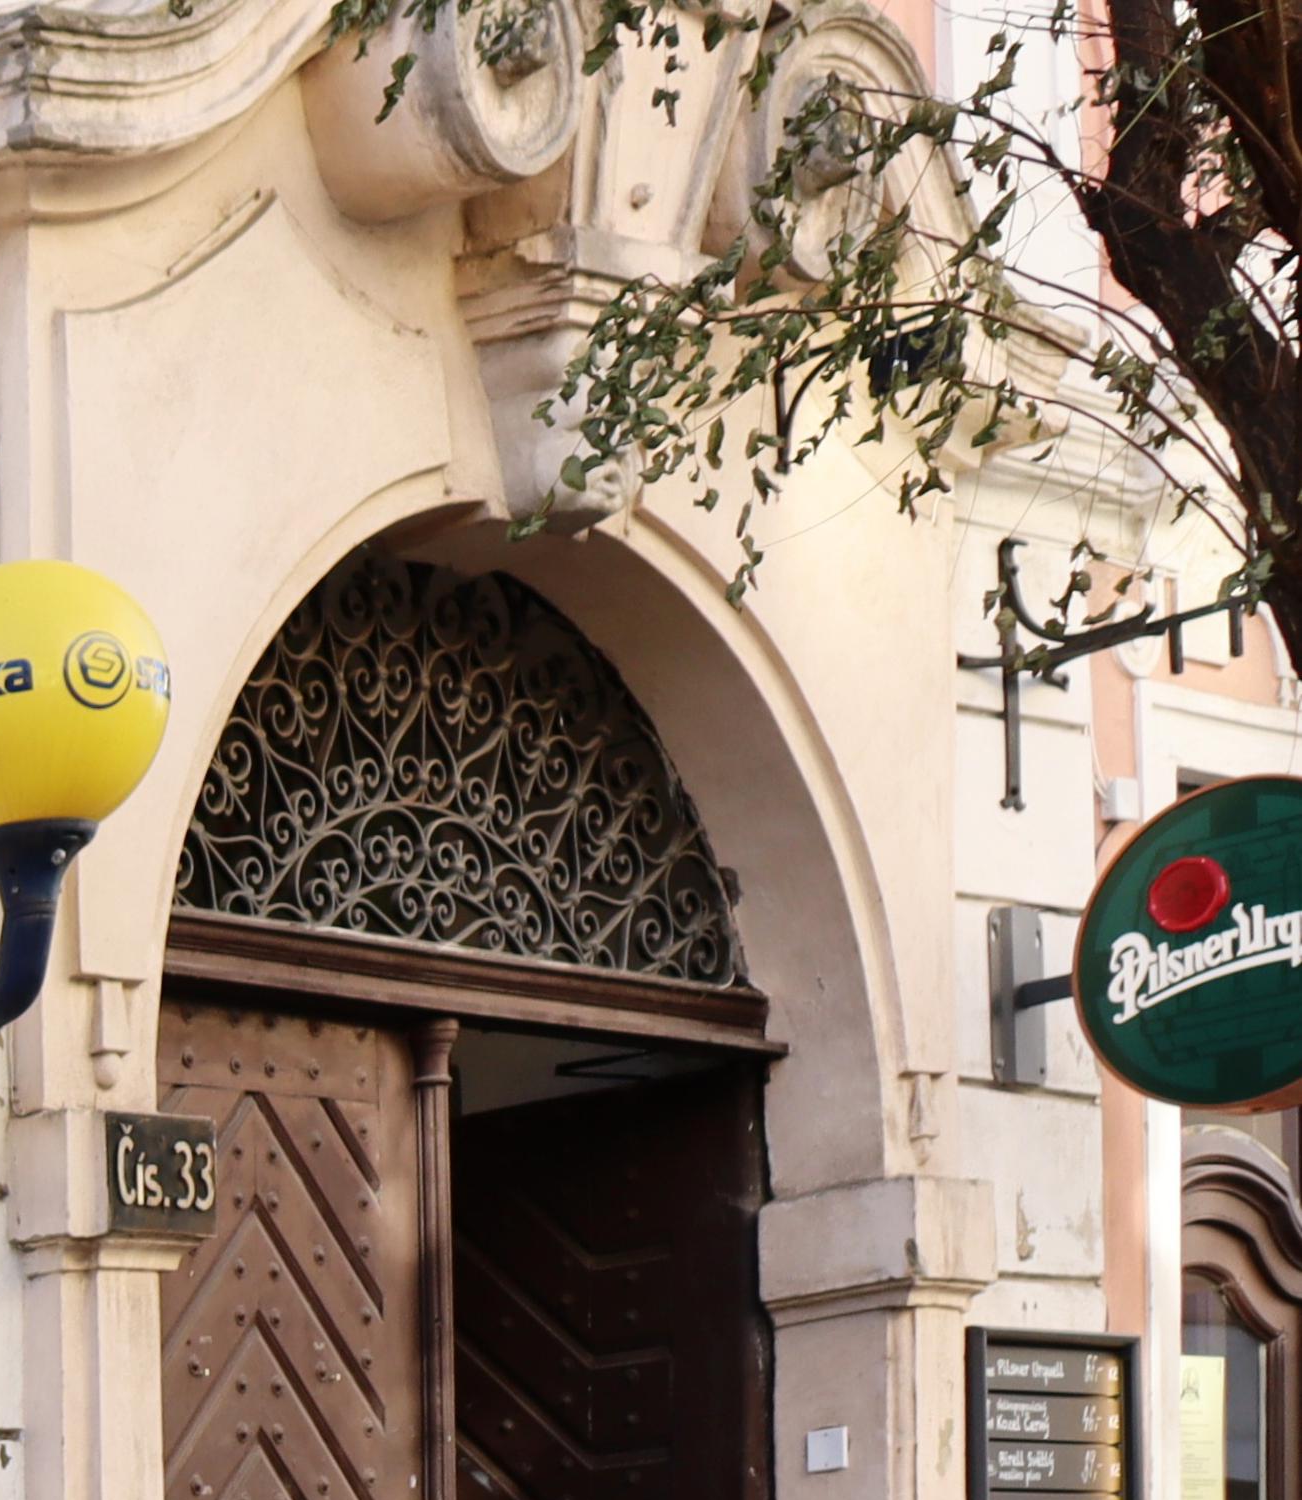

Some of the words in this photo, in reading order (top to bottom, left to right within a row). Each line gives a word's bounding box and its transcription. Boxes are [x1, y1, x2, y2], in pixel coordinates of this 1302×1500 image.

[1107, 931, 1240, 1025] Pilsner
[117, 1122, 171, 1208] Čís.
[173, 1140, 215, 1211] 33
[996, 1358, 1030, 1377] Pilsner
[1031, 1360, 1065, 1386] Urquell
[996, 1414, 1021, 1431] Kozel
[1023, 1411, 1050, 1439] Černý
[998, 1450, 1024, 1467] Birell
